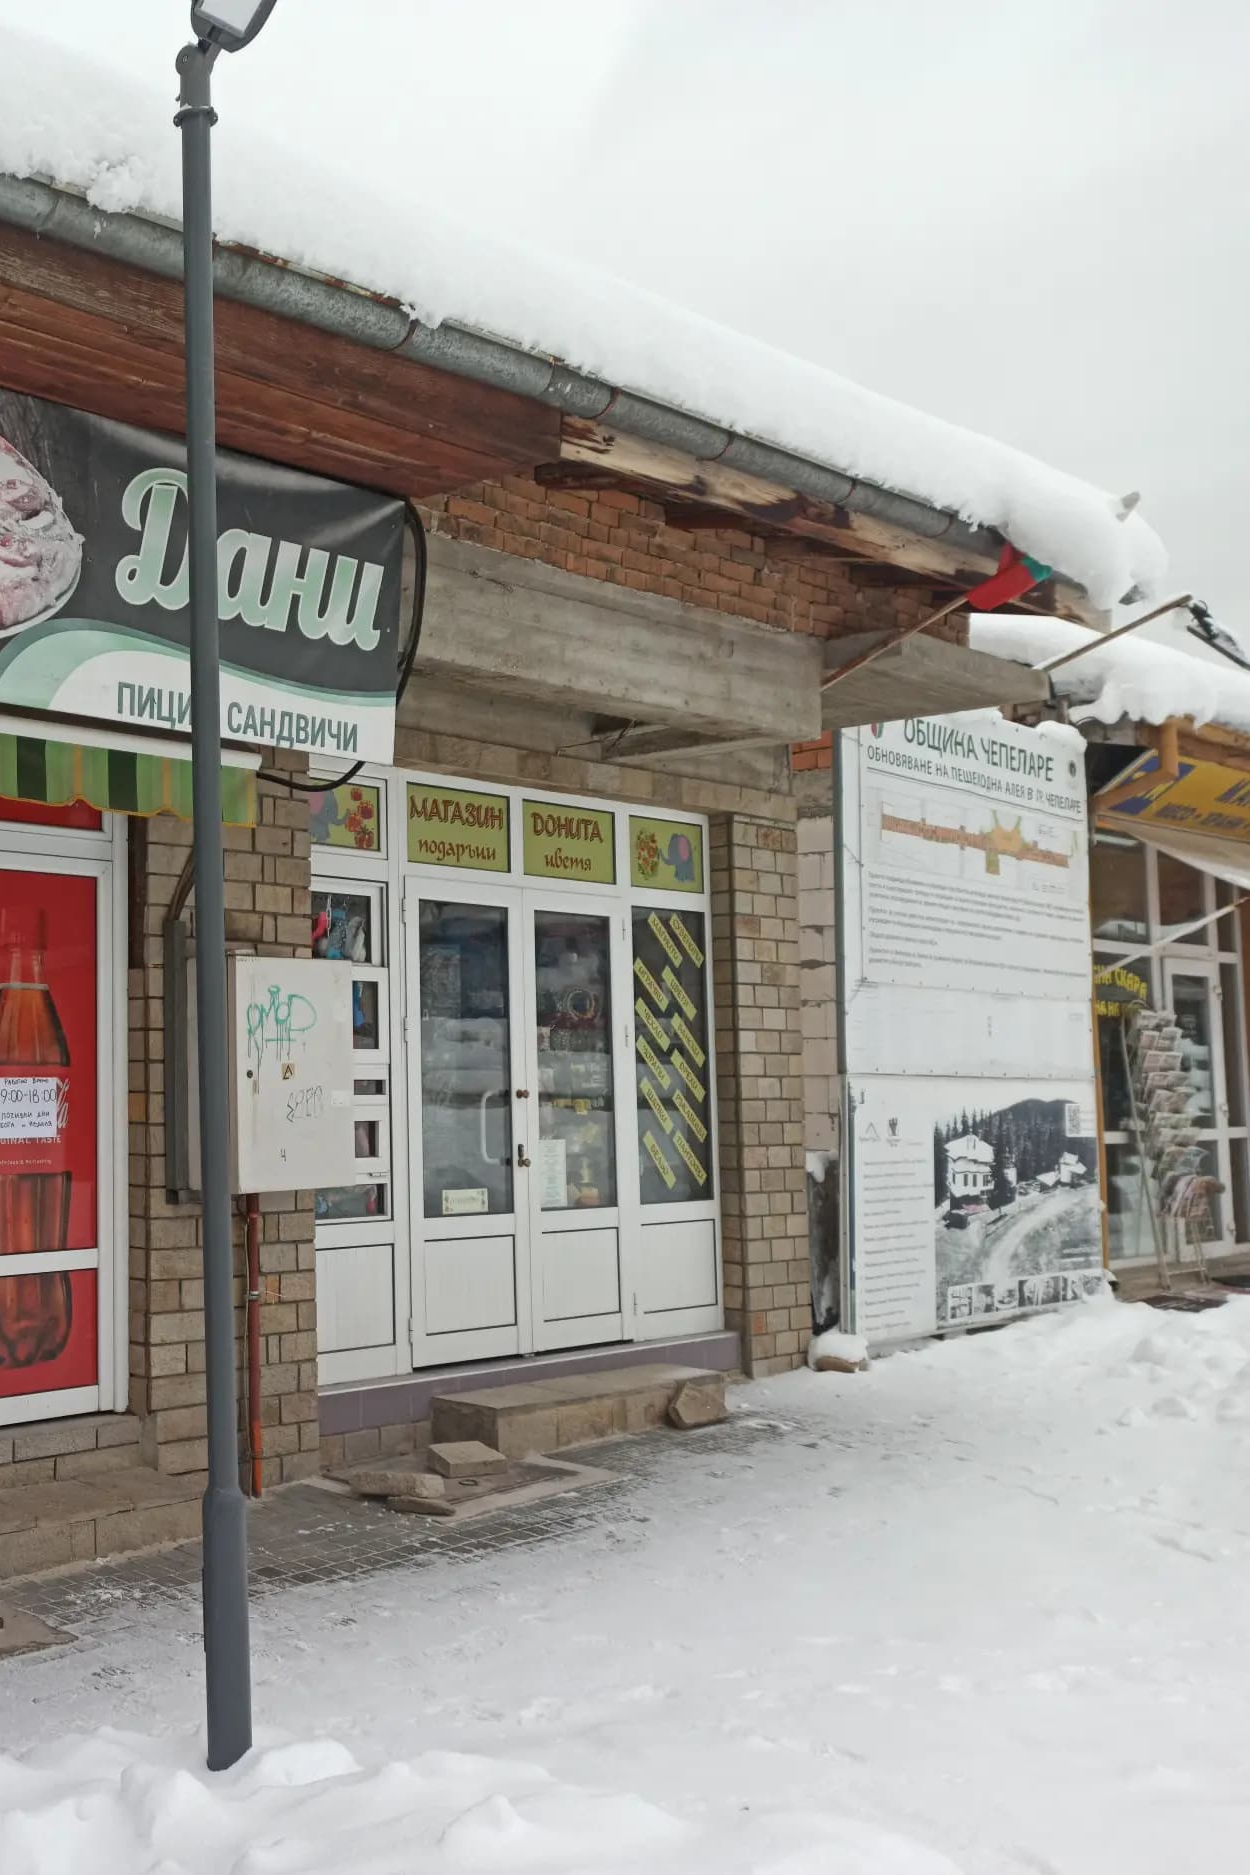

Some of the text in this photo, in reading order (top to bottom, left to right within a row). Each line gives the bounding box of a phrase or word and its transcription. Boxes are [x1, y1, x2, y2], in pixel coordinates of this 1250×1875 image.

[115, 467, 385, 651] Дани
[117, 681, 358, 753] ПИЦИ САНДВИЧИ
[867, 745, 933, 776] ОБНОВЯВАНЕ
[935, 763, 950, 779] НА
[951, 766, 1003, 793] ПЕШЕХОДНА
[1005, 781, 1025, 798] АЛЕЯ
[1026, 787, 1034, 800] В
[1045, 792, 1082, 814] ЧЕПЕЛАРЕ
[903, 718, 1054, 782] ОБЩИНА ЧЕПЕЛАРЕ
[409, 795, 504, 830] МАГАЗИН
[418, 837, 496, 863] подаръци
[543, 847, 592, 871] цветя
